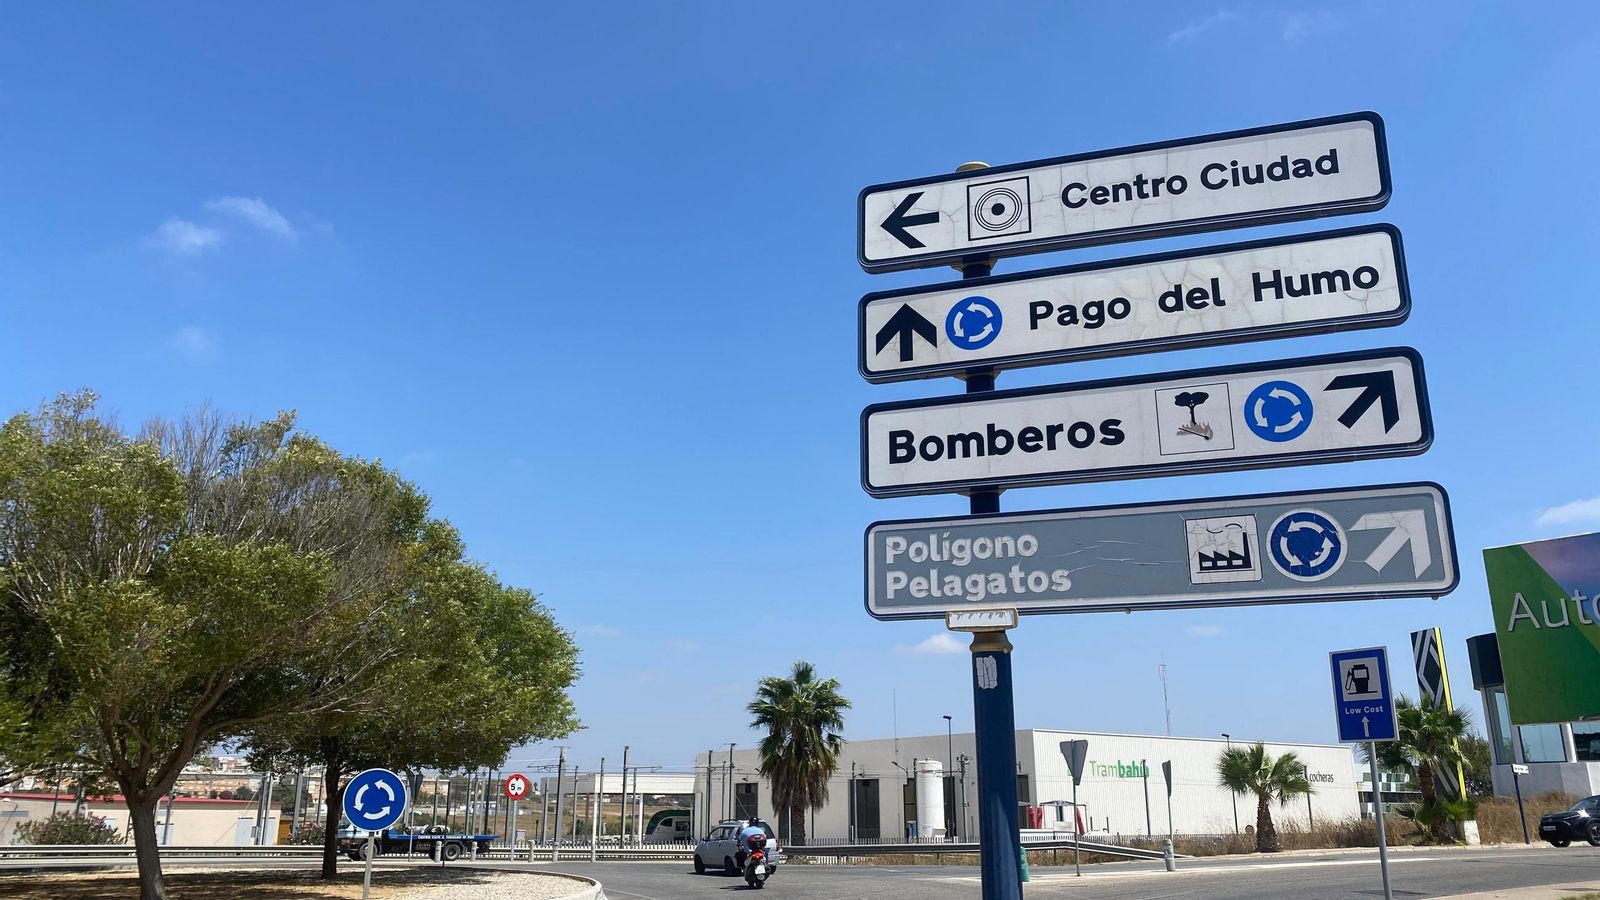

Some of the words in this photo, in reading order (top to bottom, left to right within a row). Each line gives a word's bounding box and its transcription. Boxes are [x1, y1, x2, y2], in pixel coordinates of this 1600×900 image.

[1061, 173, 1188, 208] Centro
[1200, 149, 1339, 190] Ciudad
[1029, 297, 1131, 331] Pago
[1158, 278, 1226, 313] del
[1252, 265, 1380, 303] Humo
[888, 417, 1125, 465] Bomberos
[885, 532, 1039, 567] Polígono
[885, 564, 1073, 601] Pelagatos
[1344, 707, 1362, 715] Low
[1363, 705, 1384, 714] Cost
[510, 783, 516, 791] 5
[1309, 770, 1334, 783] cocheras
